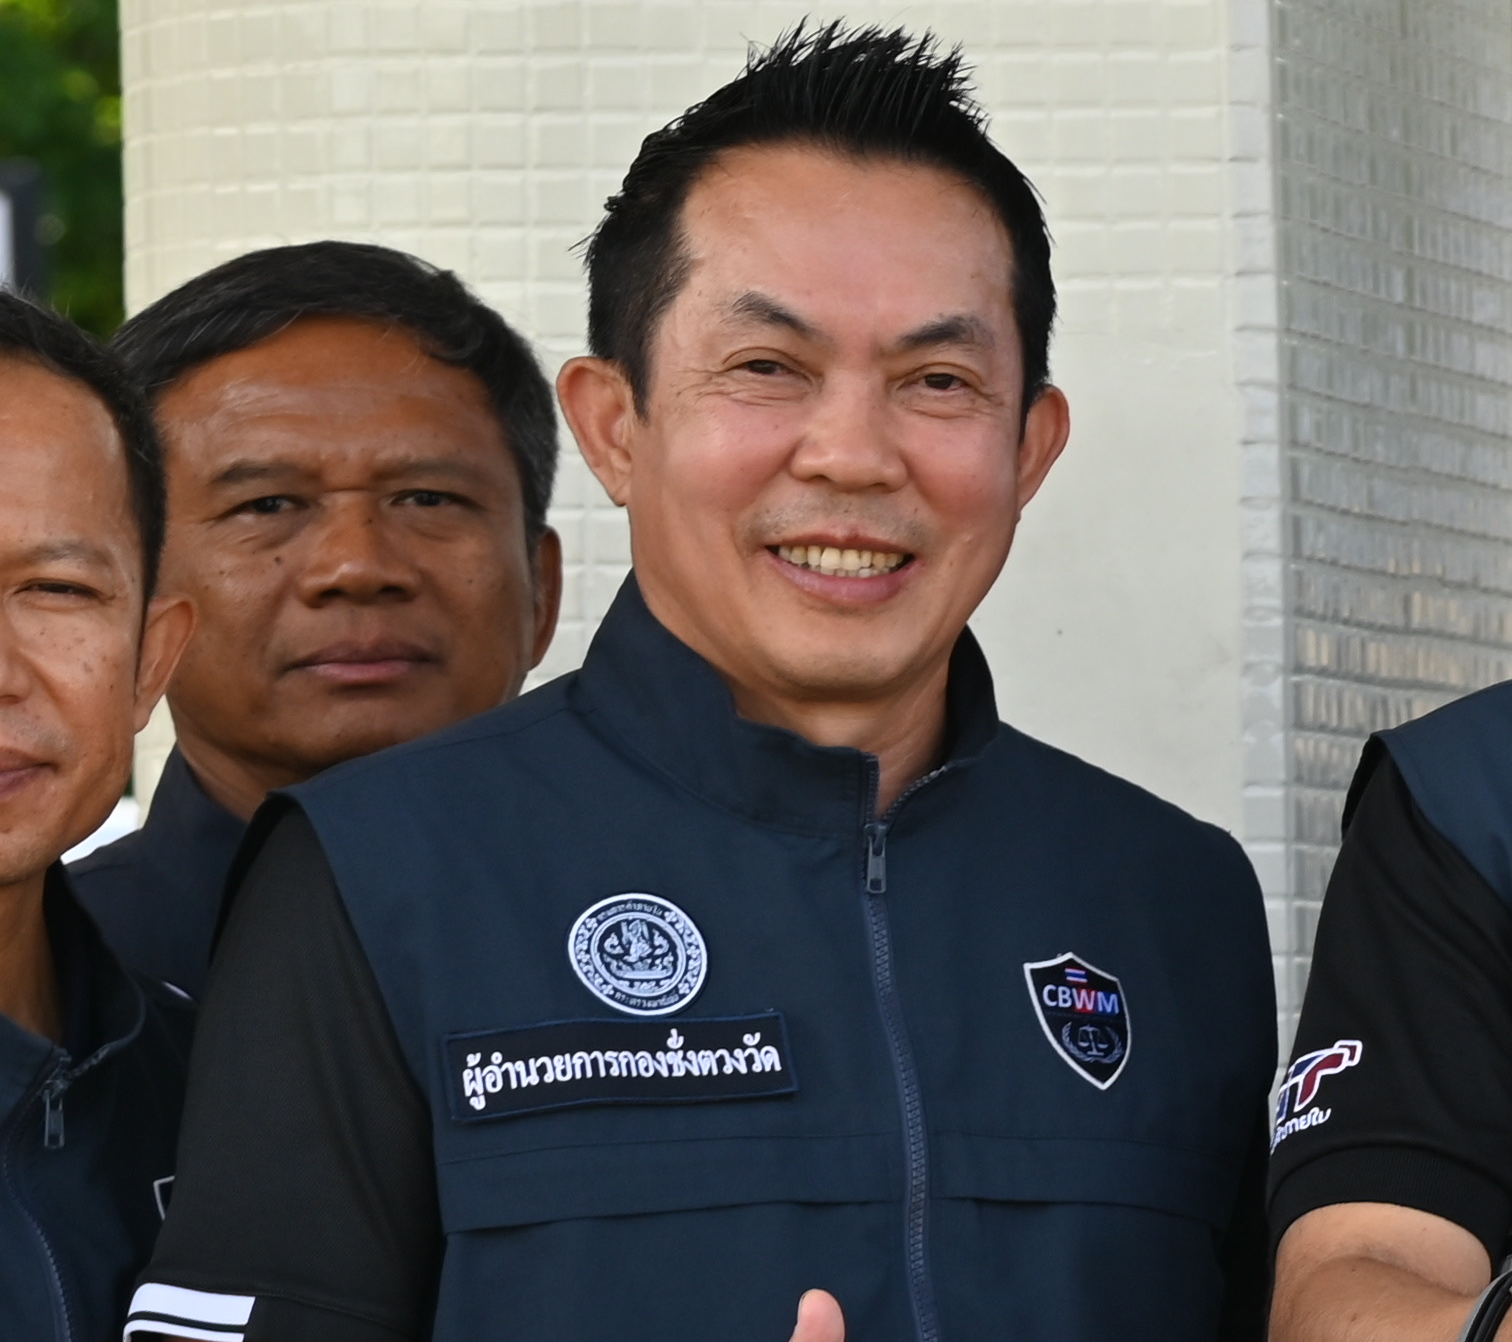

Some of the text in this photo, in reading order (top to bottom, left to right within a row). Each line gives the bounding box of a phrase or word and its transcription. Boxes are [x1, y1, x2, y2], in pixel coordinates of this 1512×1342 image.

[1041, 983, 1120, 1014] CBWM
[461, 1028, 782, 1111] ผู้อำนวยการกองชั่งตวงวัด
